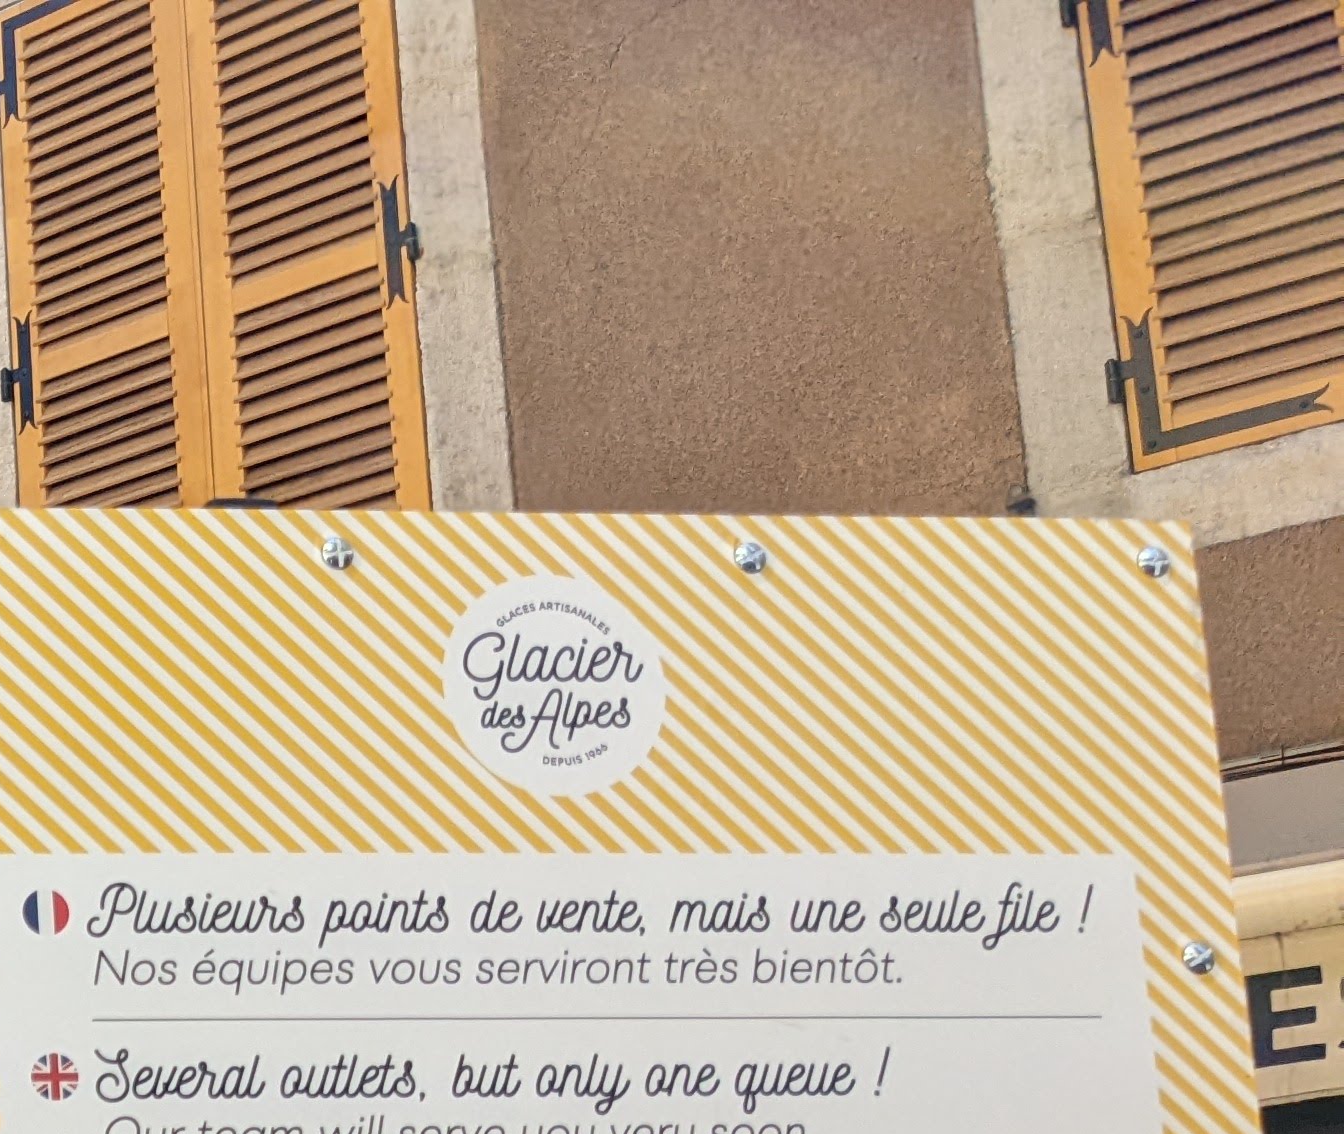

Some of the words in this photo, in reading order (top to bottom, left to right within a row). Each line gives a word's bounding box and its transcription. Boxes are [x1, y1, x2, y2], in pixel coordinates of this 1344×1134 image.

[496, 603, 536, 628] GLACES
[538, 601, 611, 636] ARTISANALES
[463, 631, 644, 701] Glacier
[480, 700, 527, 729] des
[500, 688, 632, 754] Alpes
[542, 754, 583, 767] DEPUIS
[87, 882, 306, 939] Plusieurs
[318, 890, 450, 948] points
[470, 890, 523, 934] de
[536, 890, 647, 936] vente,
[669, 893, 771, 934] mais
[790, 899, 866, 934] une
[879, 890, 985, 934] seule
[982, 881, 1060, 950] file
[93, 950, 178, 987] Nos
[192, 949, 354, 996] équipes
[369, 956, 462, 986] vous
[475, 951, 651, 986] serviront
[664, 948, 739, 985] très
[753, 948, 904, 985] bientôt.
[94, 1048, 266, 1104] Several
[280, 1053, 427, 1103] outlets,
[451, 1053, 521, 1098] but
[536, 1053, 631, 1116] only
[645, 1061, 720, 1097] one
[734, 1060, 856, 1114] queue
